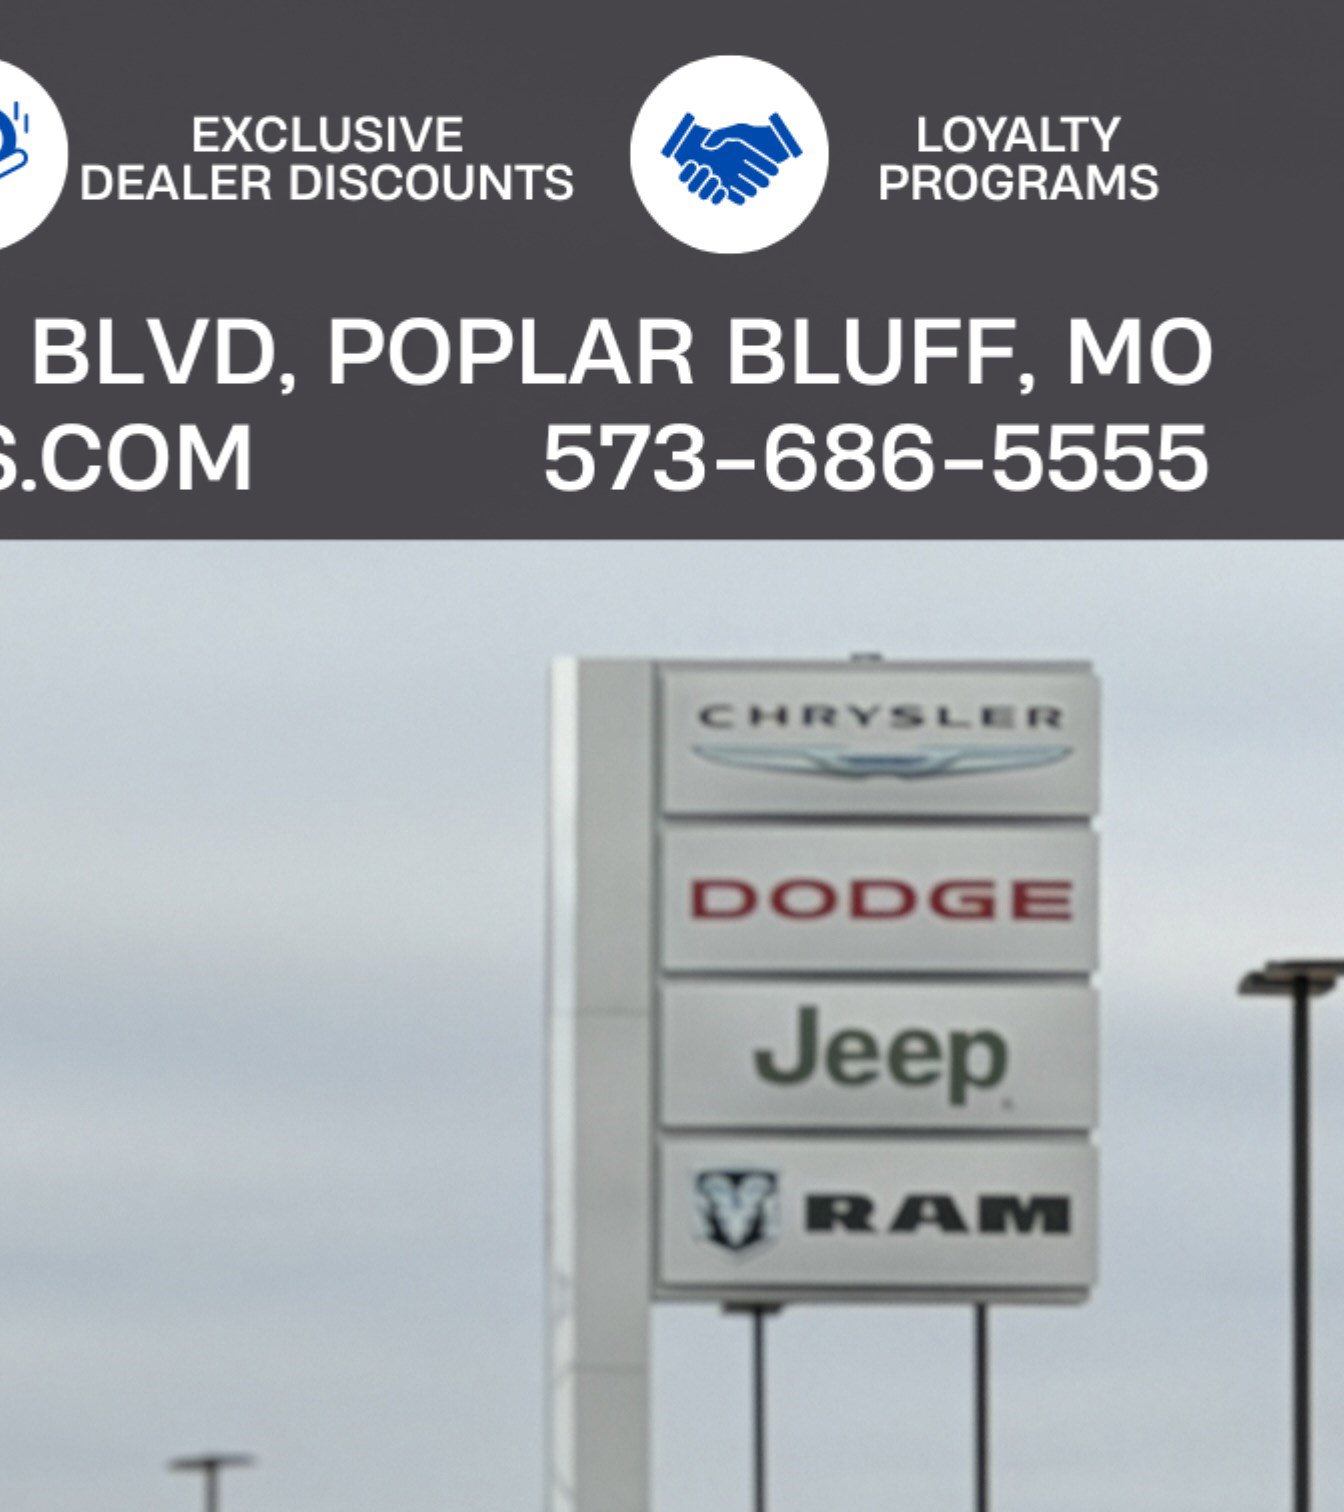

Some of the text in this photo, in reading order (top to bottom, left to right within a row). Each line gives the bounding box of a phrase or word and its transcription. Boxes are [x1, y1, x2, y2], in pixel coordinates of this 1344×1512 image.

[697, 704, 1065, 730] CHRYSLER
[690, 878, 1074, 921] DODGE
[753, 1005, 1010, 1107] Jeep
[804, 1193, 1073, 1236] RAM
